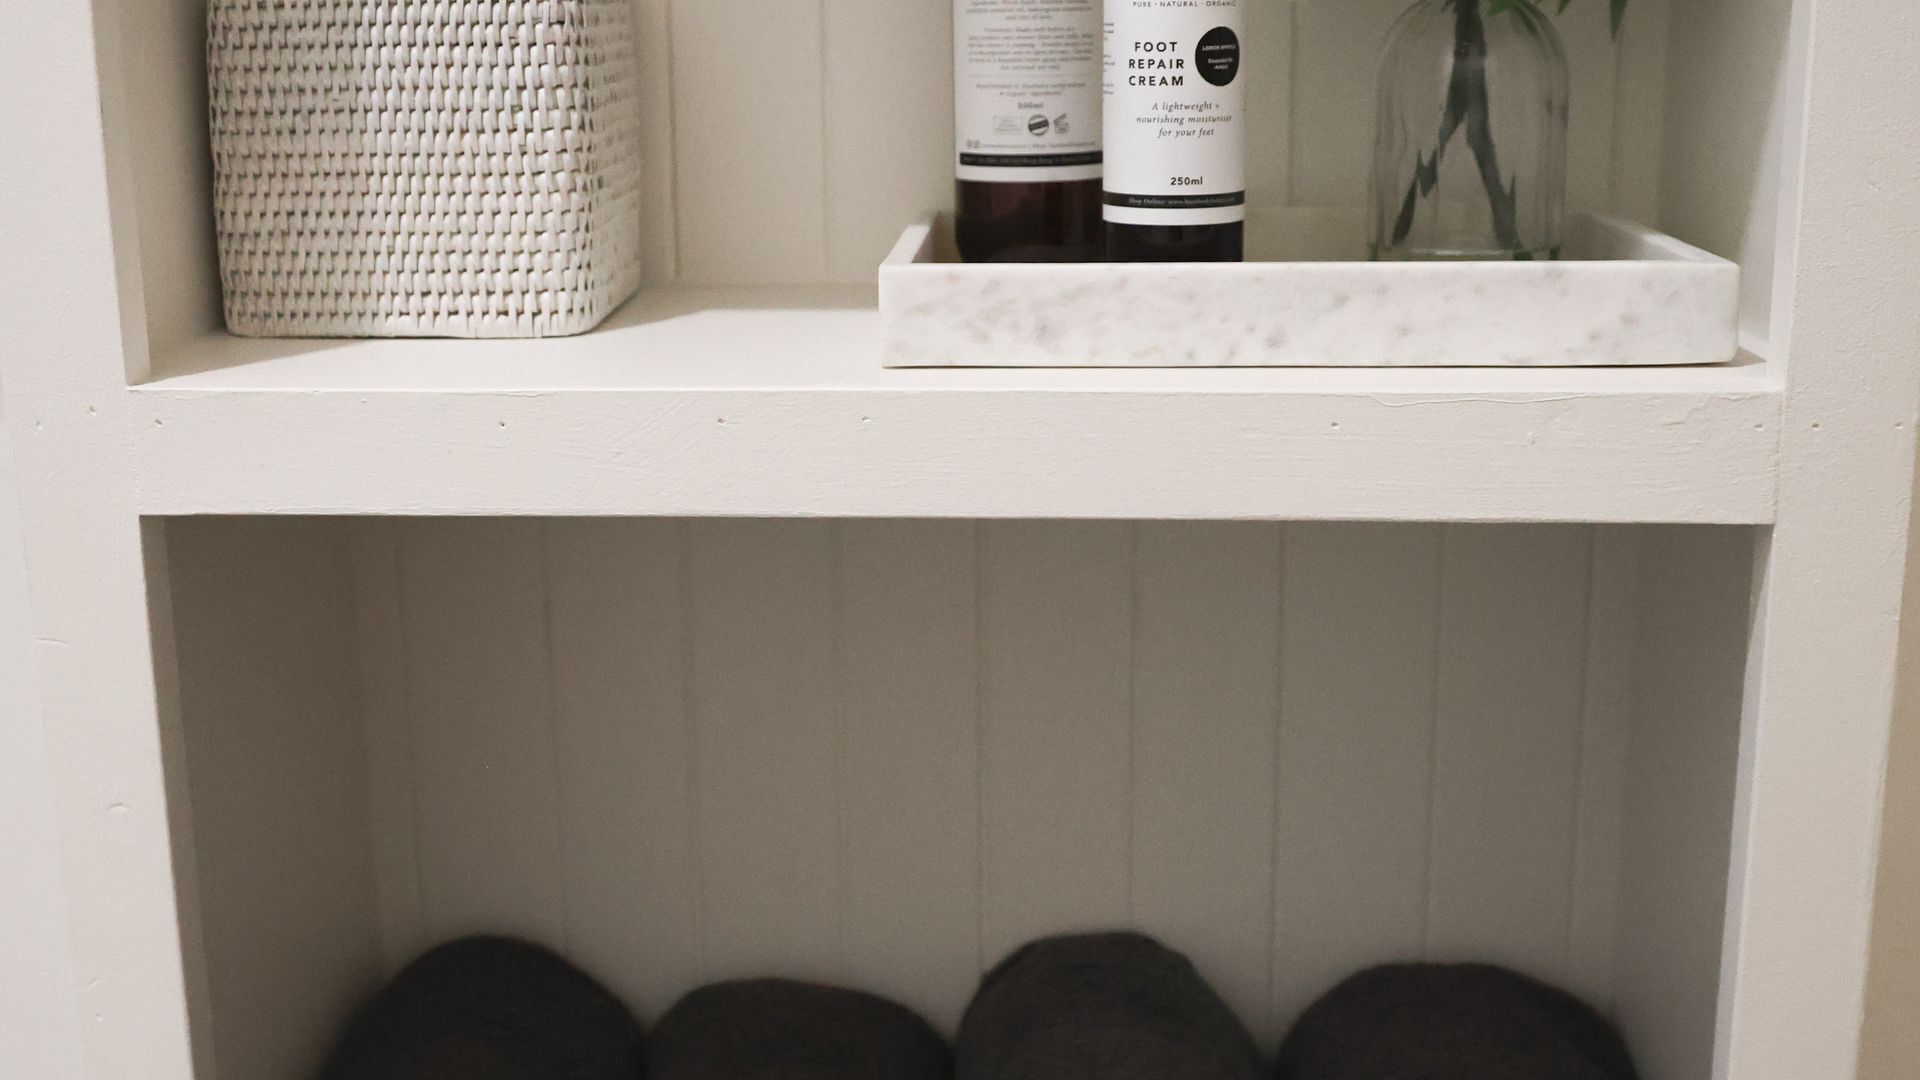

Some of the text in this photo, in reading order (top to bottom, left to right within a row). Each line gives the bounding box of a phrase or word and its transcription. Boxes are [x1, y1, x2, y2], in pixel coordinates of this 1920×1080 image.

[1134, 42, 1178, 52] FOOT
[1128, 59, 1184, 69] REPAIR
[1128, 76, 1184, 86] CREAM
[1151, 102, 1159, 111] A
[1162, 101, 1213, 113] lightweight
[1136, 114, 1185, 126] nourishing
[1157, 127, 1215, 139] for your feet
[1170, 176, 1203, 186] 250ml
